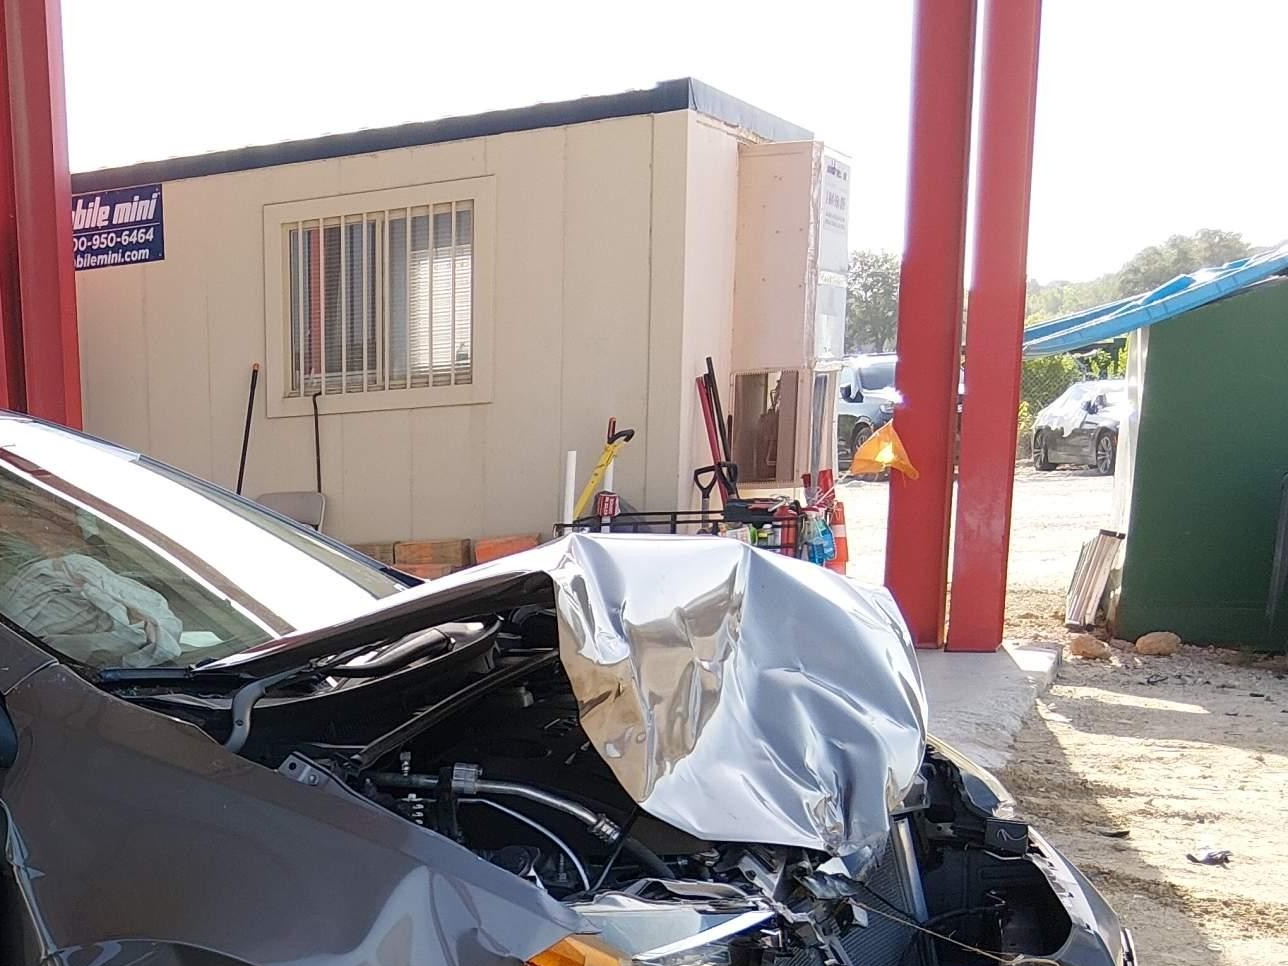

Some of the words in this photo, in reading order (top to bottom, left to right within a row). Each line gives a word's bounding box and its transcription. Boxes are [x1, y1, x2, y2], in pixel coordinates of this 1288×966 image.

[72, 196, 110, 230] bile
[112, 193, 158, 224] mini
[74, 248, 150, 268] bilemini.com
